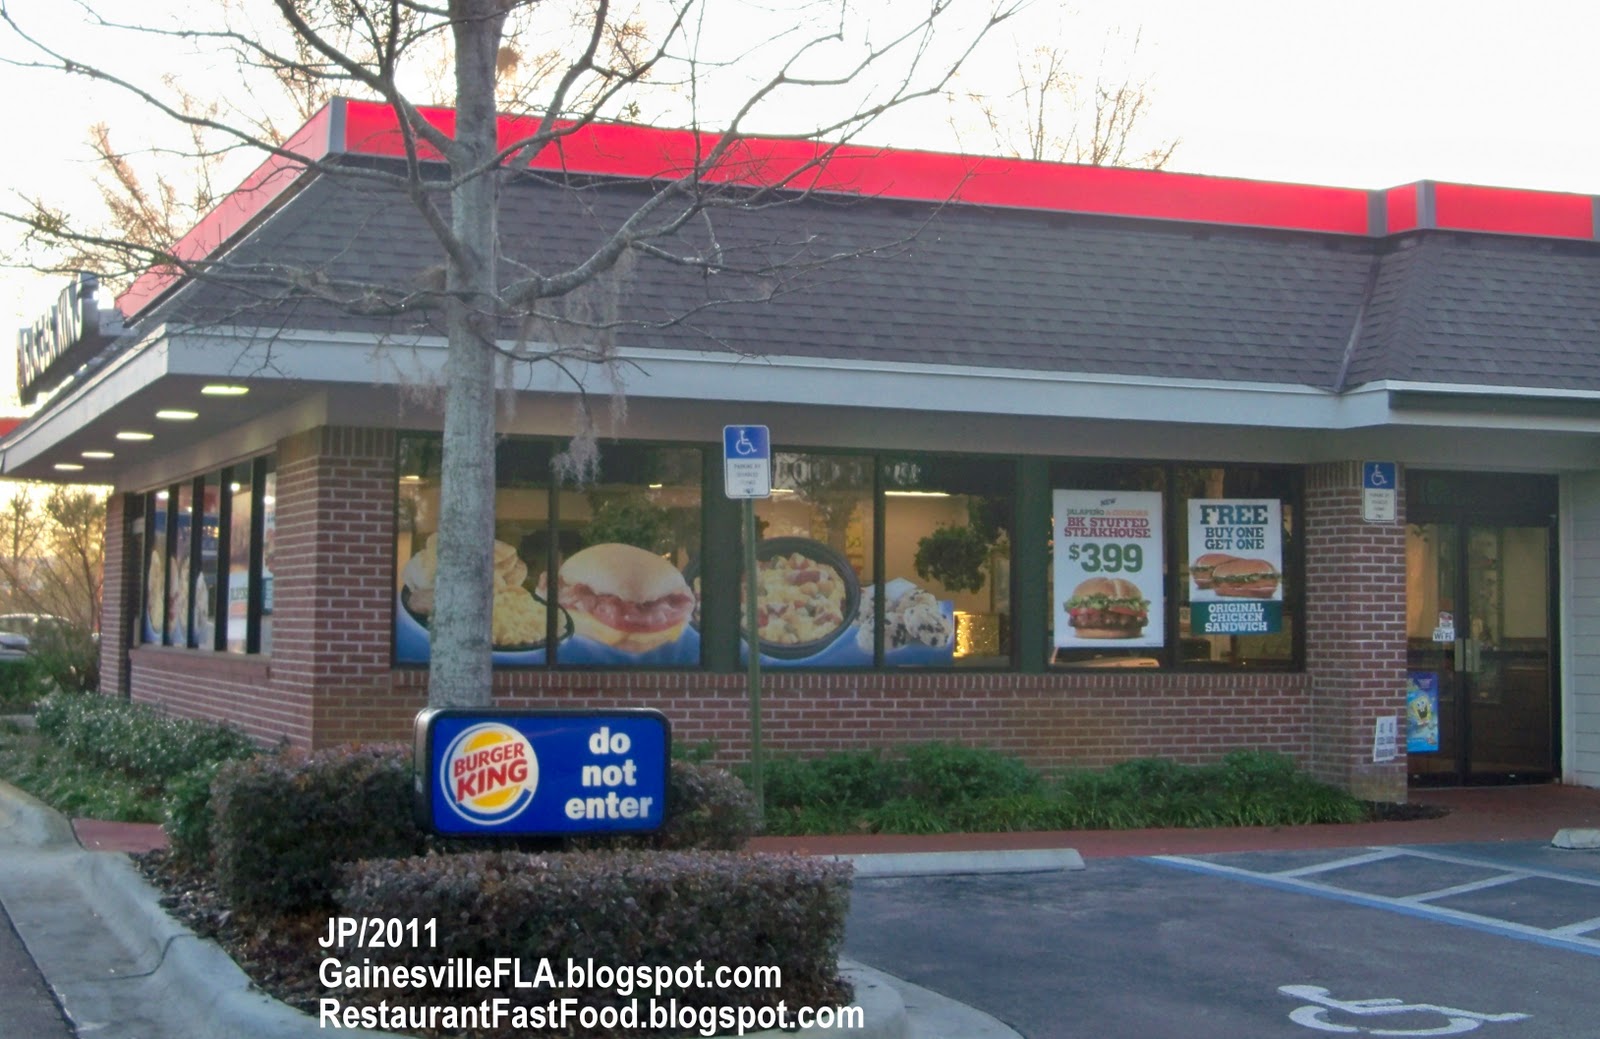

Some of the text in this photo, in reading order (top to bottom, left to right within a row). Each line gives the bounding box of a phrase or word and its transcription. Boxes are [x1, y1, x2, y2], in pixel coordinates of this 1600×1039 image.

[1100, 498, 1117, 506] NEW
[1200, 505, 1268, 525] FREE
[1067, 517, 1149, 528] BK STUFFED
[1064, 527, 1151, 539] STEAKHOUSE
[1205, 527, 1264, 538] BUY ONE
[1205, 539, 1264, 550] GET ONE
[1208, 603, 1264, 613] ORIGINAL
[1209, 612, 1263, 622] CHICKEN
[1205, 621, 1267, 632] SANDWICH
[588, 727, 631, 755] do
[453, 742, 525, 778] BURGER
[582, 759, 637, 787] not
[456, 759, 528, 803] KING
[565, 792, 653, 820] enter
